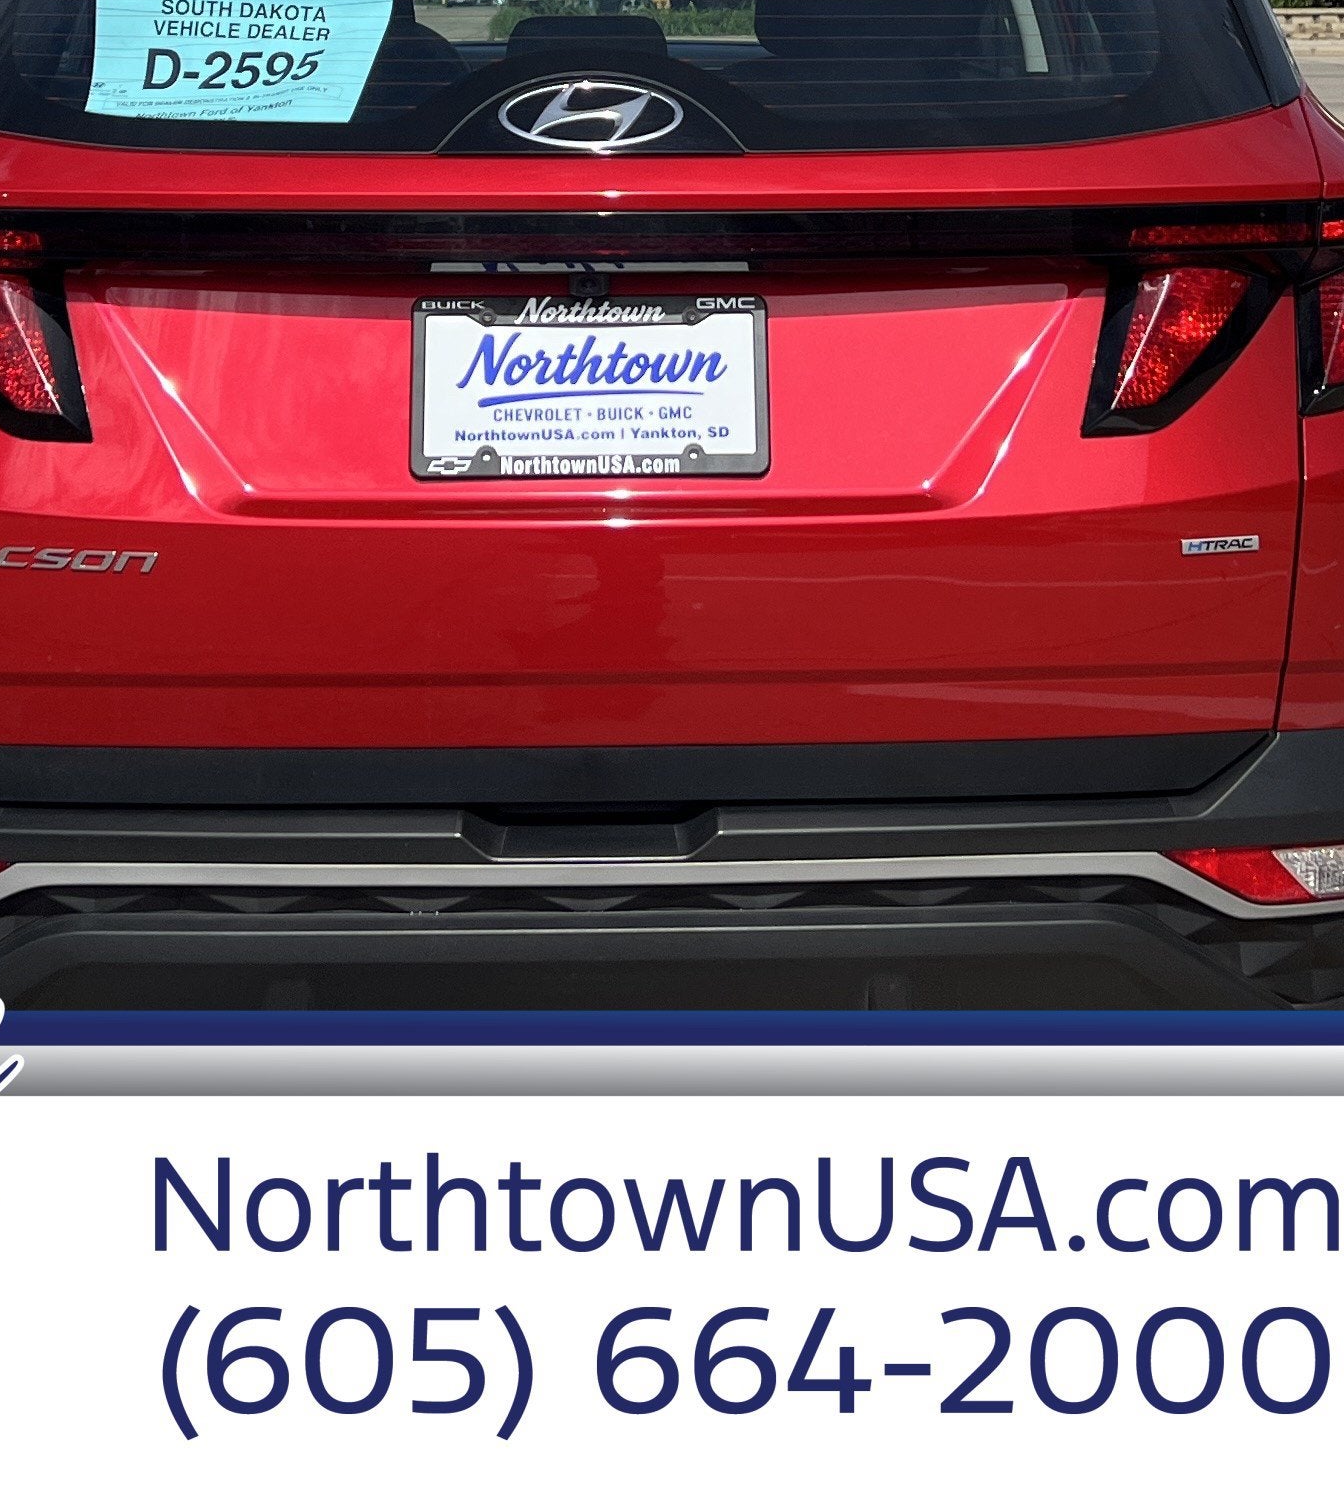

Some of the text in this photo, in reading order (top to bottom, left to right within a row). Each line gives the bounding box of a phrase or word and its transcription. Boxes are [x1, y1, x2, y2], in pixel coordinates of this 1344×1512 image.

[161, 0, 327, 22] SOUTH DAKOTA
[154, 19, 331, 42] VEHICLE DEALER
[142, 48, 325, 90] D-2595
[421, 300, 485, 310] BUICK
[514, 296, 666, 325] Northtown
[696, 296, 756, 310] GMC
[456, 332, 727, 388] Northtown
[493, 406, 692, 422] CHEVROLET BUICK GMC
[455, 426, 730, 442] NorthtownUSA.com Yankton, SD
[500, 454, 681, 476] NorthtownUSA.com
[1187, 538, 1254, 552] HTRAC
